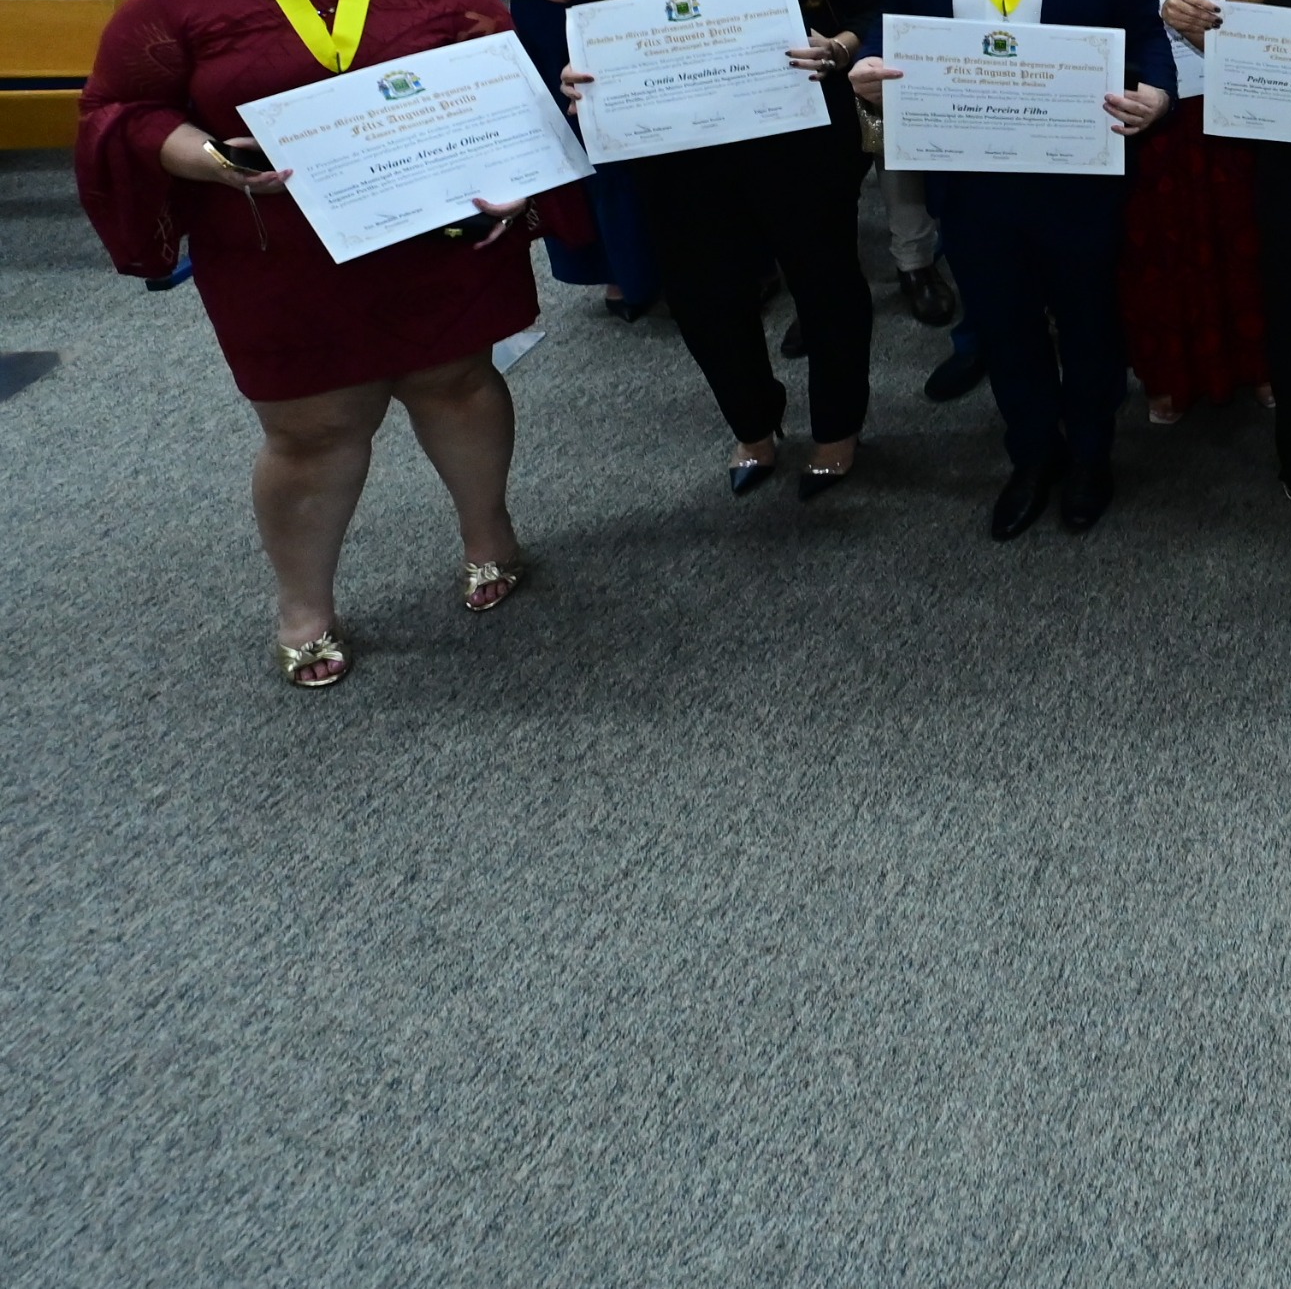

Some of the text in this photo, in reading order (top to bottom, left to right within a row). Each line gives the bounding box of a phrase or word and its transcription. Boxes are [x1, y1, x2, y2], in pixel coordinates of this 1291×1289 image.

[635, 25, 742, 51] Félix Augusto Perillo
[1264, 45, 1287, 55] Félix
[644, 64, 750, 88] Cyntia Magalhães Dias
[944, 65, 1054, 80] Félix Augusto Perillo
[1247, 75, 1288, 87] Pollyanna
[352, 94, 477, 138] Félix Augusto Perillo
[952, 103, 1048, 116] Valmir Pereira Filho
[369, 130, 500, 174] Viviane Alves de Oliveira
